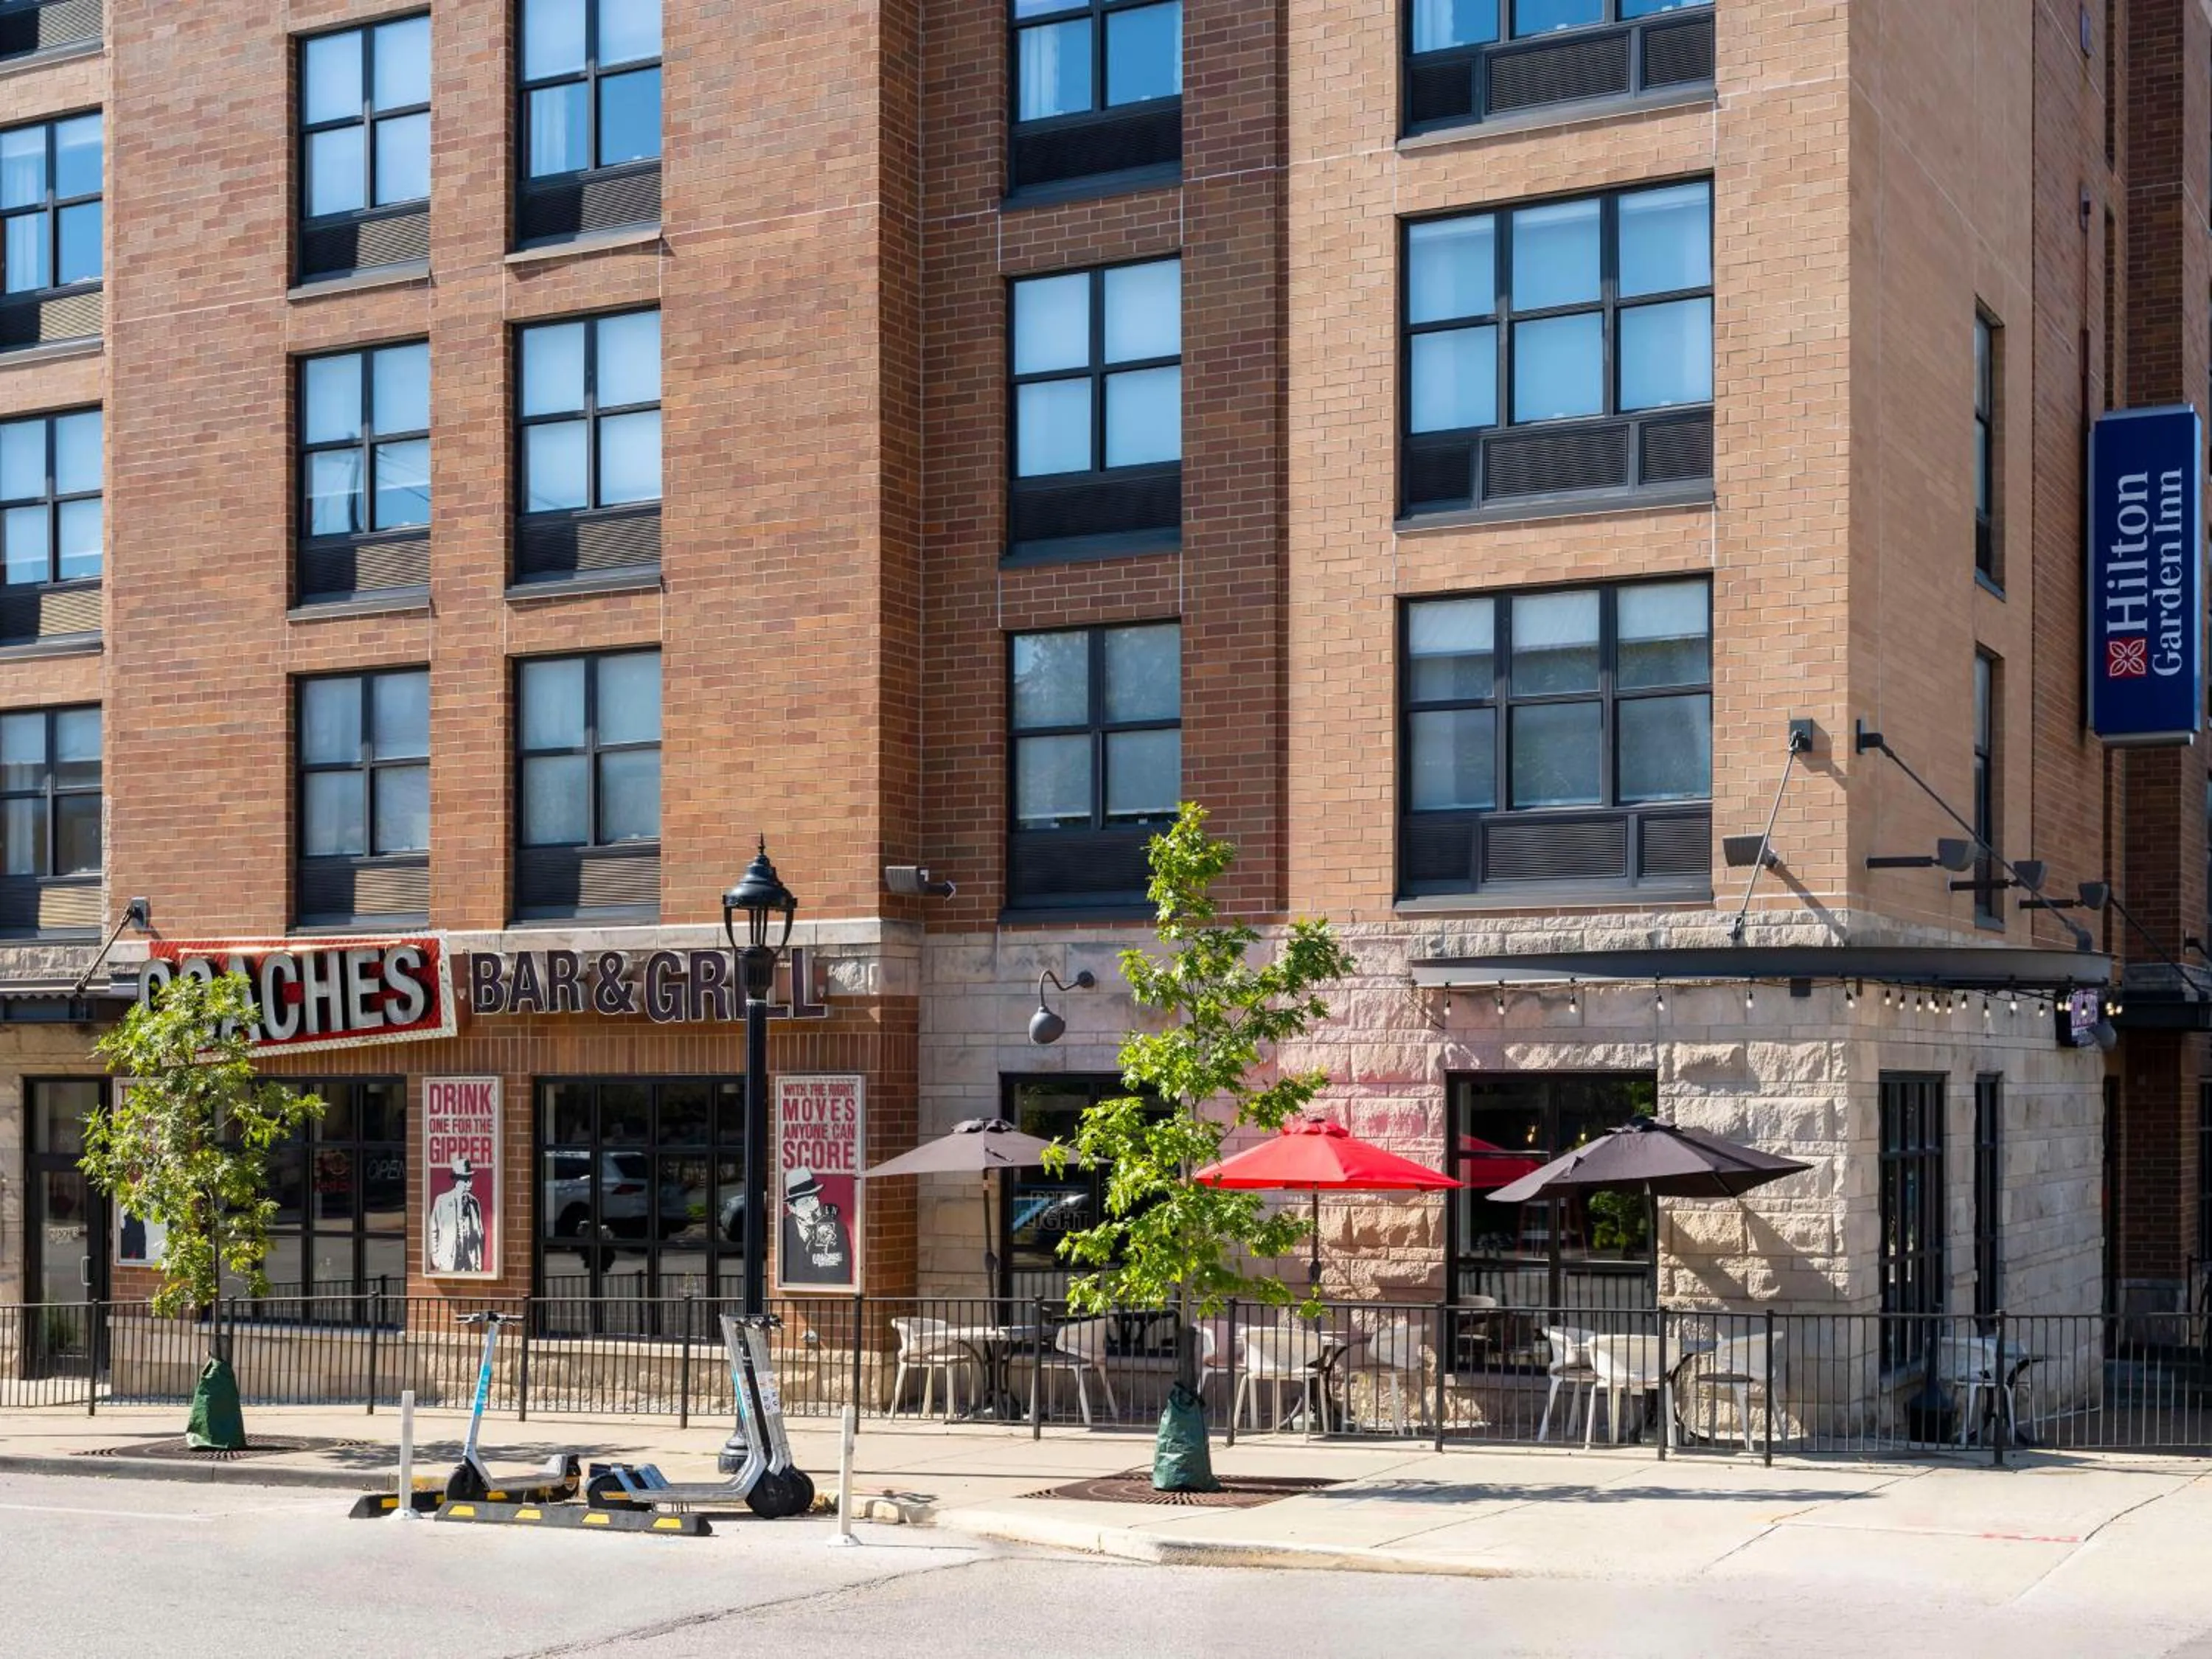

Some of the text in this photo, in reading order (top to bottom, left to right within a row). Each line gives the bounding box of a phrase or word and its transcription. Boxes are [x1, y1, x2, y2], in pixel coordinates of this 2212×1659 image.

[2106, 470, 2149, 634] Hilton
[2152, 467, 2183, 677] Garden Inn
[428, 1083, 493, 1116] DRINK
[810, 1083, 825, 1096] THE
[782, 1098, 855, 1121] MOVES
[429, 1118, 494, 1133] ONE FOR THE
[783, 1123, 855, 1139] ANYONE CAN
[429, 1136, 493, 1164] GIPPER
[782, 1140, 855, 1170] SCORE
[366, 1159, 406, 1180] OPEN
